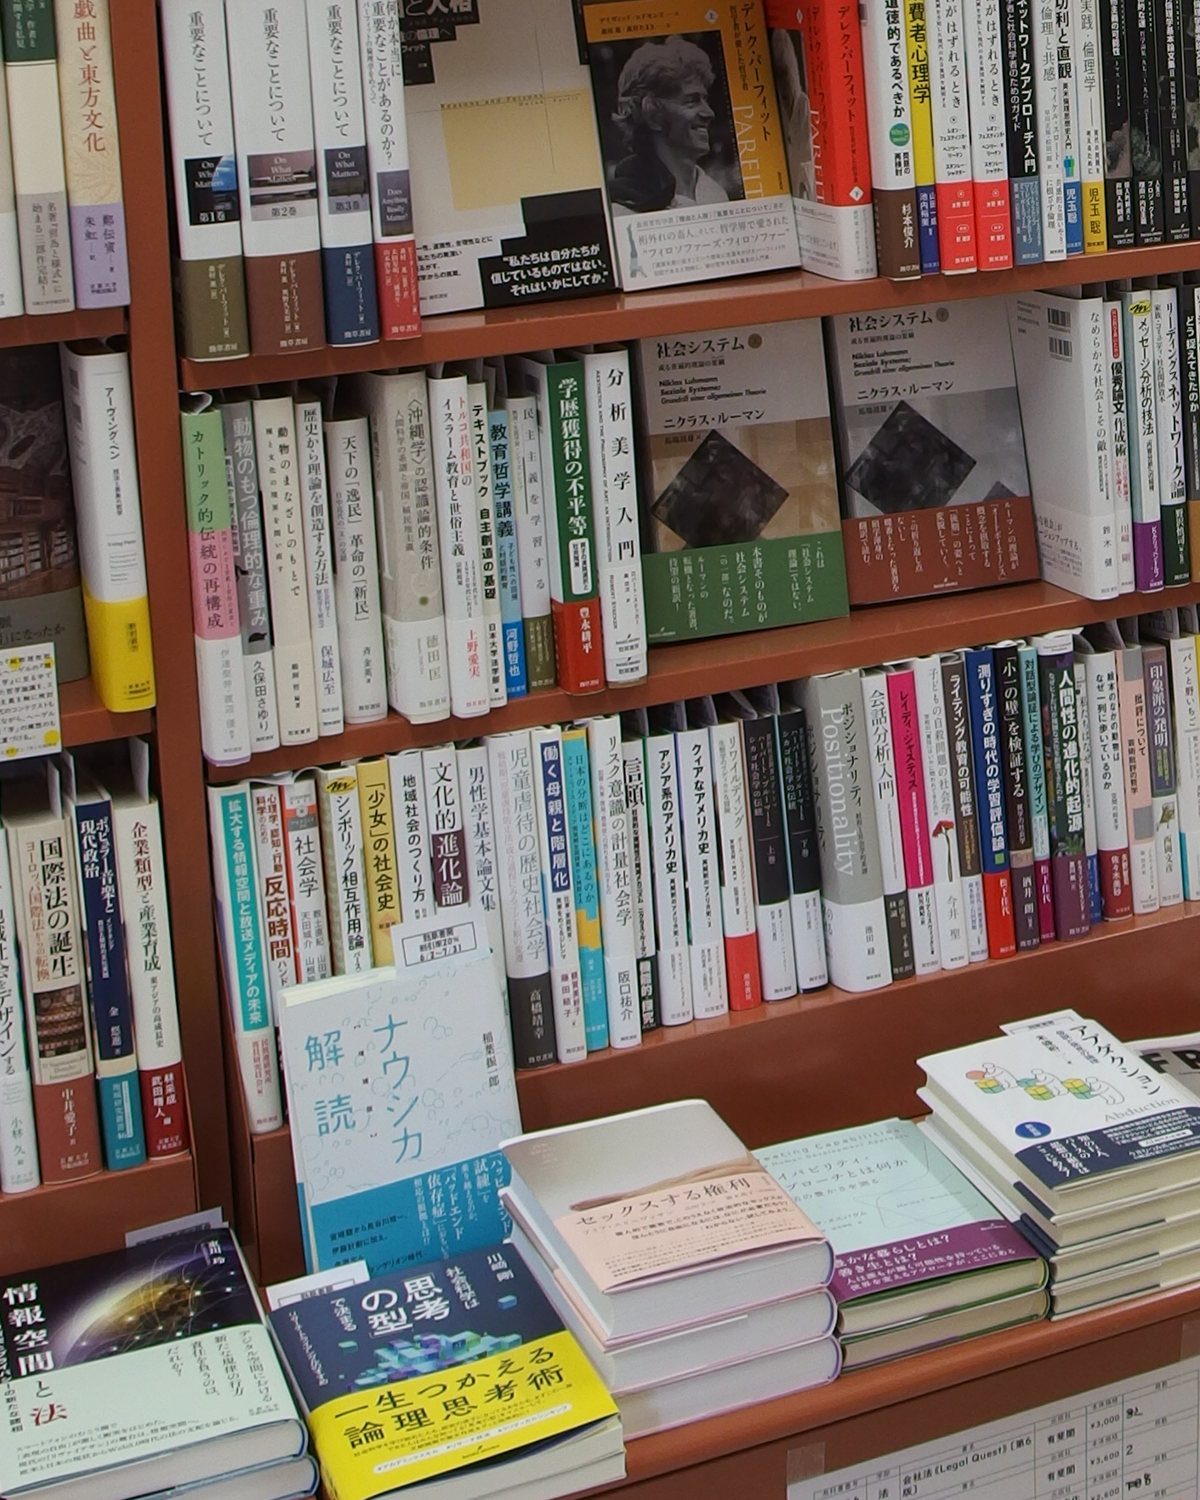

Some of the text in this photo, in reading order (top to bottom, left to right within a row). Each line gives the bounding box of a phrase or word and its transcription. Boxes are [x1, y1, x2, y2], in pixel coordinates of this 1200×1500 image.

[189, 11, 213, 147] 重要なことについて
[656, 337, 744, 358] 社会システム
[1090, 312, 1107, 452] なめらかな社会とその敵
[1138, 317, 1155, 436] メッセージ分析の技法
[490, 423, 514, 538] 教育哲学講義
[559, 377, 587, 537] 学歴獲得の不平等
[607, 369, 635, 561] 分析美学入門
[663, 408, 765, 430] ニクラス・ルーマン
[232, 417, 268, 628] 動物のもつ倫理的な重み
[303, 408, 330, 586] 歴史から理論を創造する方法
[870, 690, 895, 798] 会話分析入門
[978, 663, 1005, 850] 測りすぎの時代の学習評価論
[1002, 655, 1024, 798] 「小一の壁」を検証する
[1059, 669, 1083, 833] 人間性の進化的起源
[1150, 665, 1169, 748] 印象派の発明
[432, 761, 464, 906] 文化的進化論
[543, 744, 568, 891] 働く母親と階層化
[608, 736, 632, 926] リスク意識の計量社会学
[692, 743, 709, 854] クィアなアメリカ史
[821, 706, 855, 876] Positionality
[40, 836, 76, 979] 国際法の誕生
[132, 821, 161, 971] 企業類型と産業育成
[228, 799, 263, 1025] 拡大する情報空間と放送メディアの未来
[294, 836, 319, 898] 社会学
[335, 795, 365, 950] シンボリック相互作用論
[305, 1030, 355, 1136] 解読
[372, 1013, 423, 1165] ナウシカ
[482, 1031, 500, 1087] 稲葉振一郎
[1104, 1095, 1180, 1123] Abduction
[575, 1176, 751, 1227] セックスする権利
[334, 1347, 554, 1419] 一生つかえる
[344, 1365, 565, 1449] 論理思考術
